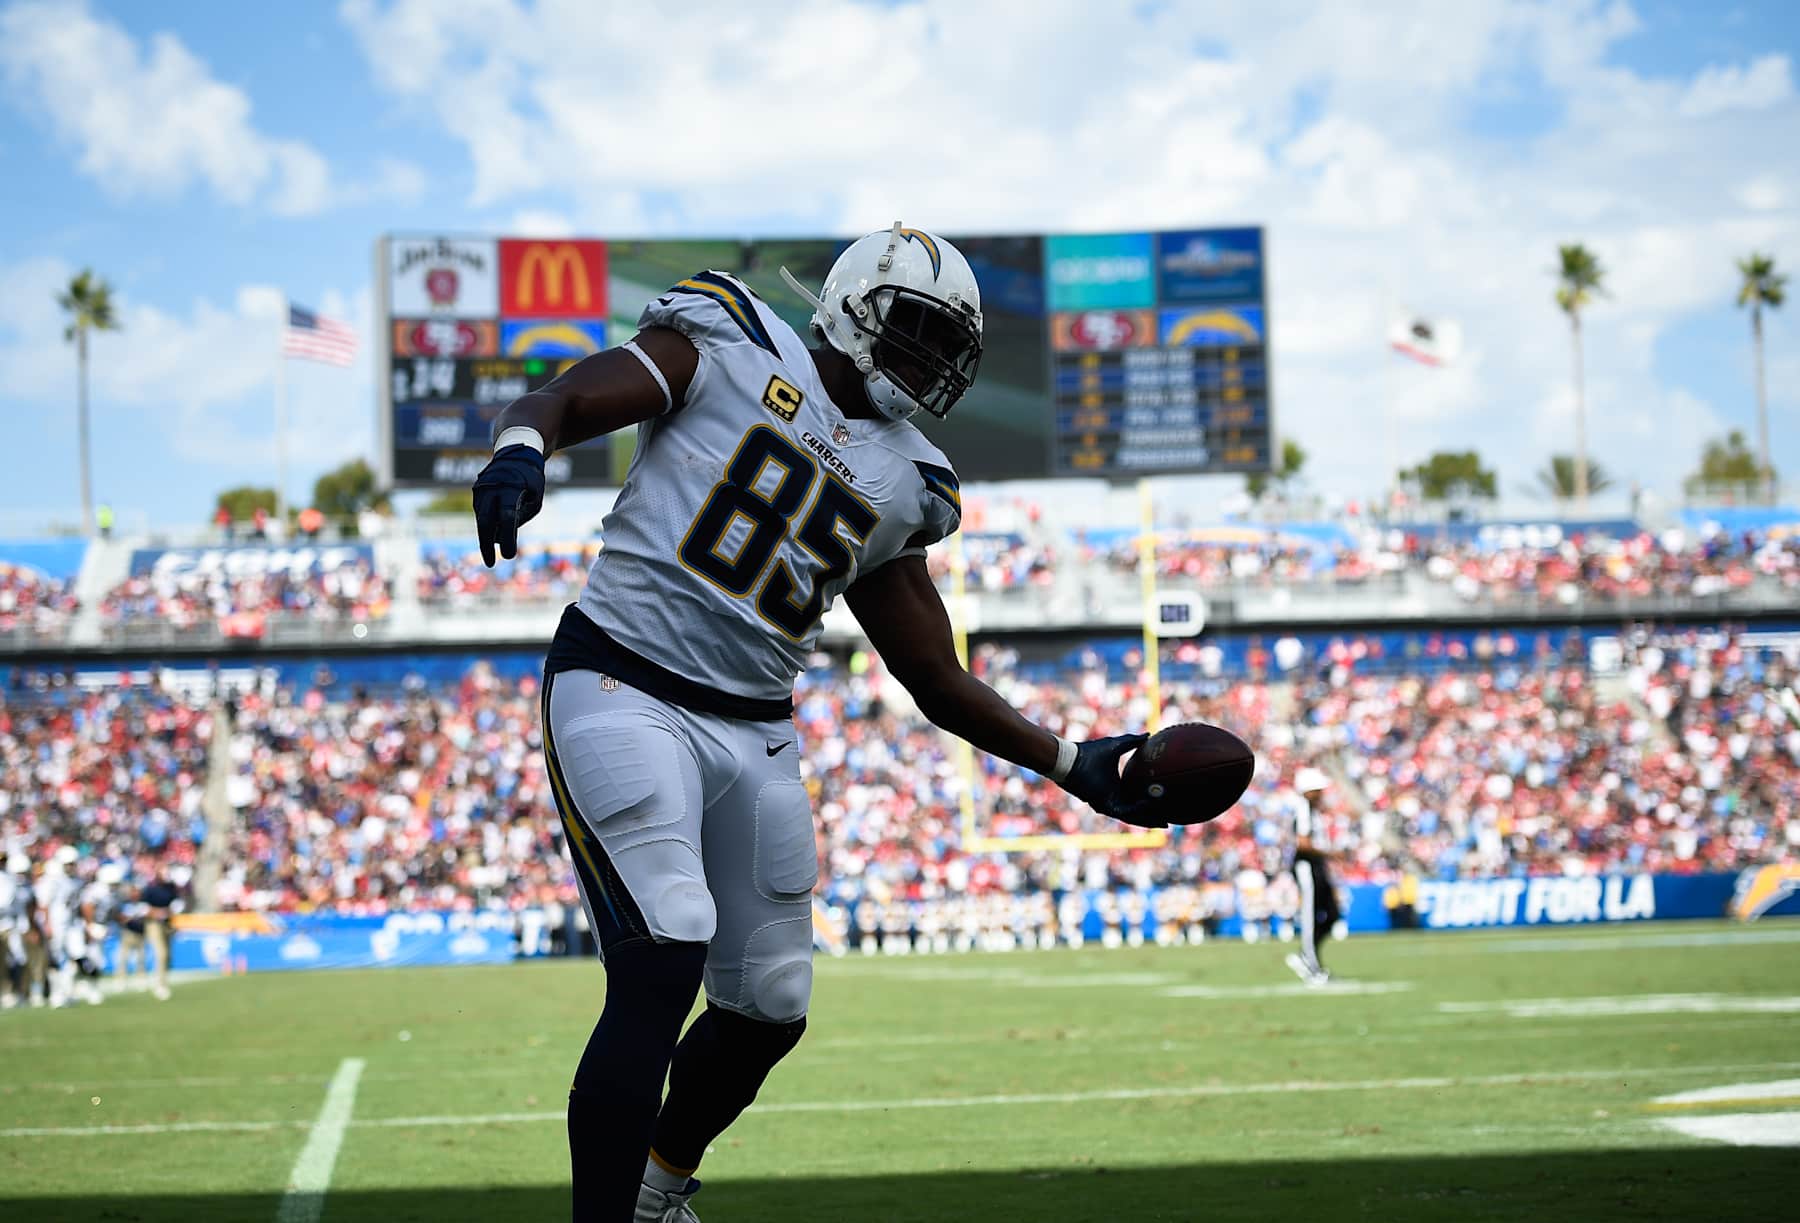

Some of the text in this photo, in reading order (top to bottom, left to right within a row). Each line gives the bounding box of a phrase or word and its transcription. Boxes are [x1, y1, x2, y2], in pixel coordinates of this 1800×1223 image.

[767, 377, 800, 413] C
[801, 431, 858, 484] CHARGERS
[676, 423, 880, 642] 85
[603, 679, 618, 689] NFL
[1414, 873, 1656, 927] FIGHT FOR LA
